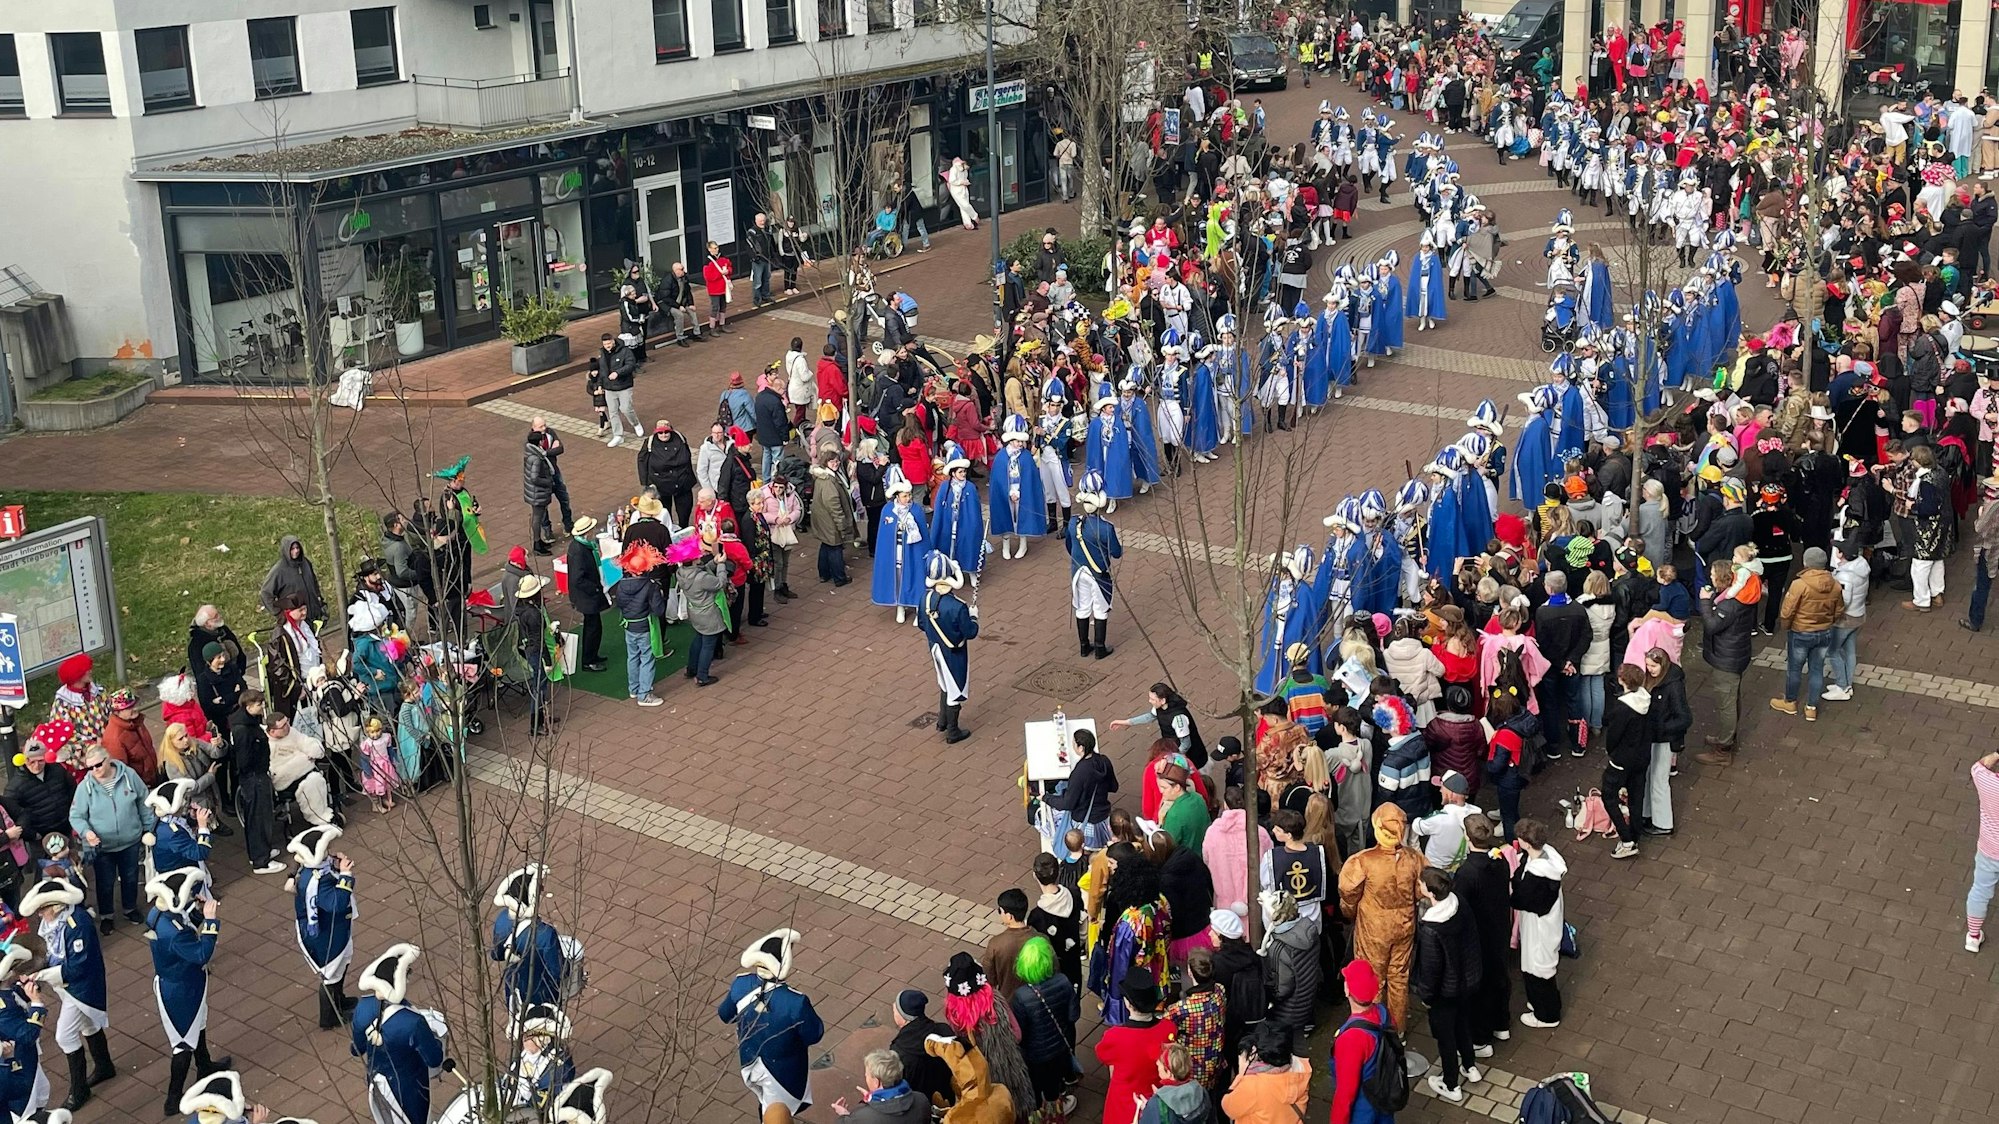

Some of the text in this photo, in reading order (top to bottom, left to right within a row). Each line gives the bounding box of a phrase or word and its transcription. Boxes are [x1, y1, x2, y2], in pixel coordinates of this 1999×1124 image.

[984, 82, 1025, 98] hrgeräte
[634, 154, 656, 168] 10-12
[20, 538, 63, 556] Information
[22, 549, 59, 565] Siegburg
[79, 559, 94, 631] INFORMATION
